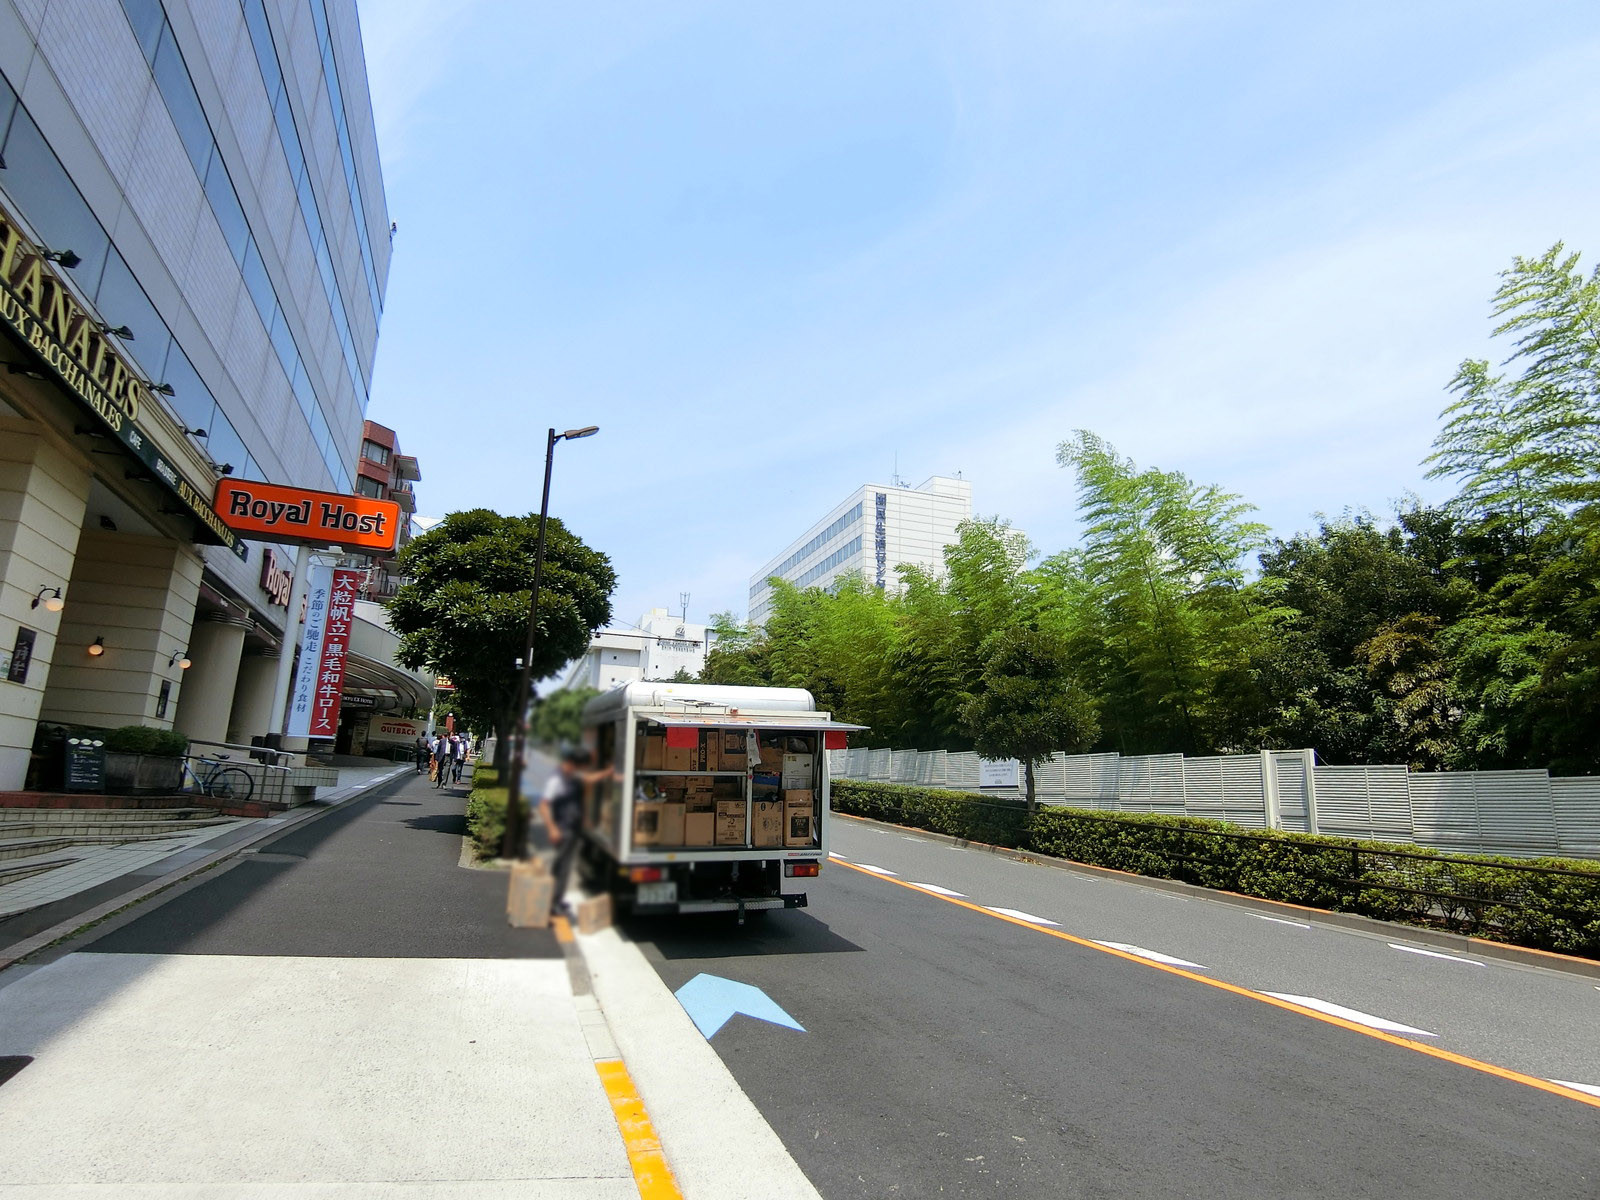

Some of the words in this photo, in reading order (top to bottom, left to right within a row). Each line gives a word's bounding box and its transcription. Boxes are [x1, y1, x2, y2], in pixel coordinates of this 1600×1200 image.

[29, 321, 122, 432] BACCHANALES
[178, 480, 196, 507] AUX
[193, 494, 235, 548] BACCHANALES
[229, 490, 313, 526] Royal
[320, 503, 387, 536] Host
[265, 550, 293, 607] Royal
[304, 588, 327, 653] 季節のご馳走
[315, 575, 355, 730] 大粒帆立・黒毛和牛ロース
[295, 657, 315, 713] こだわり食材
[381, 725, 417, 736] OUTBACK
